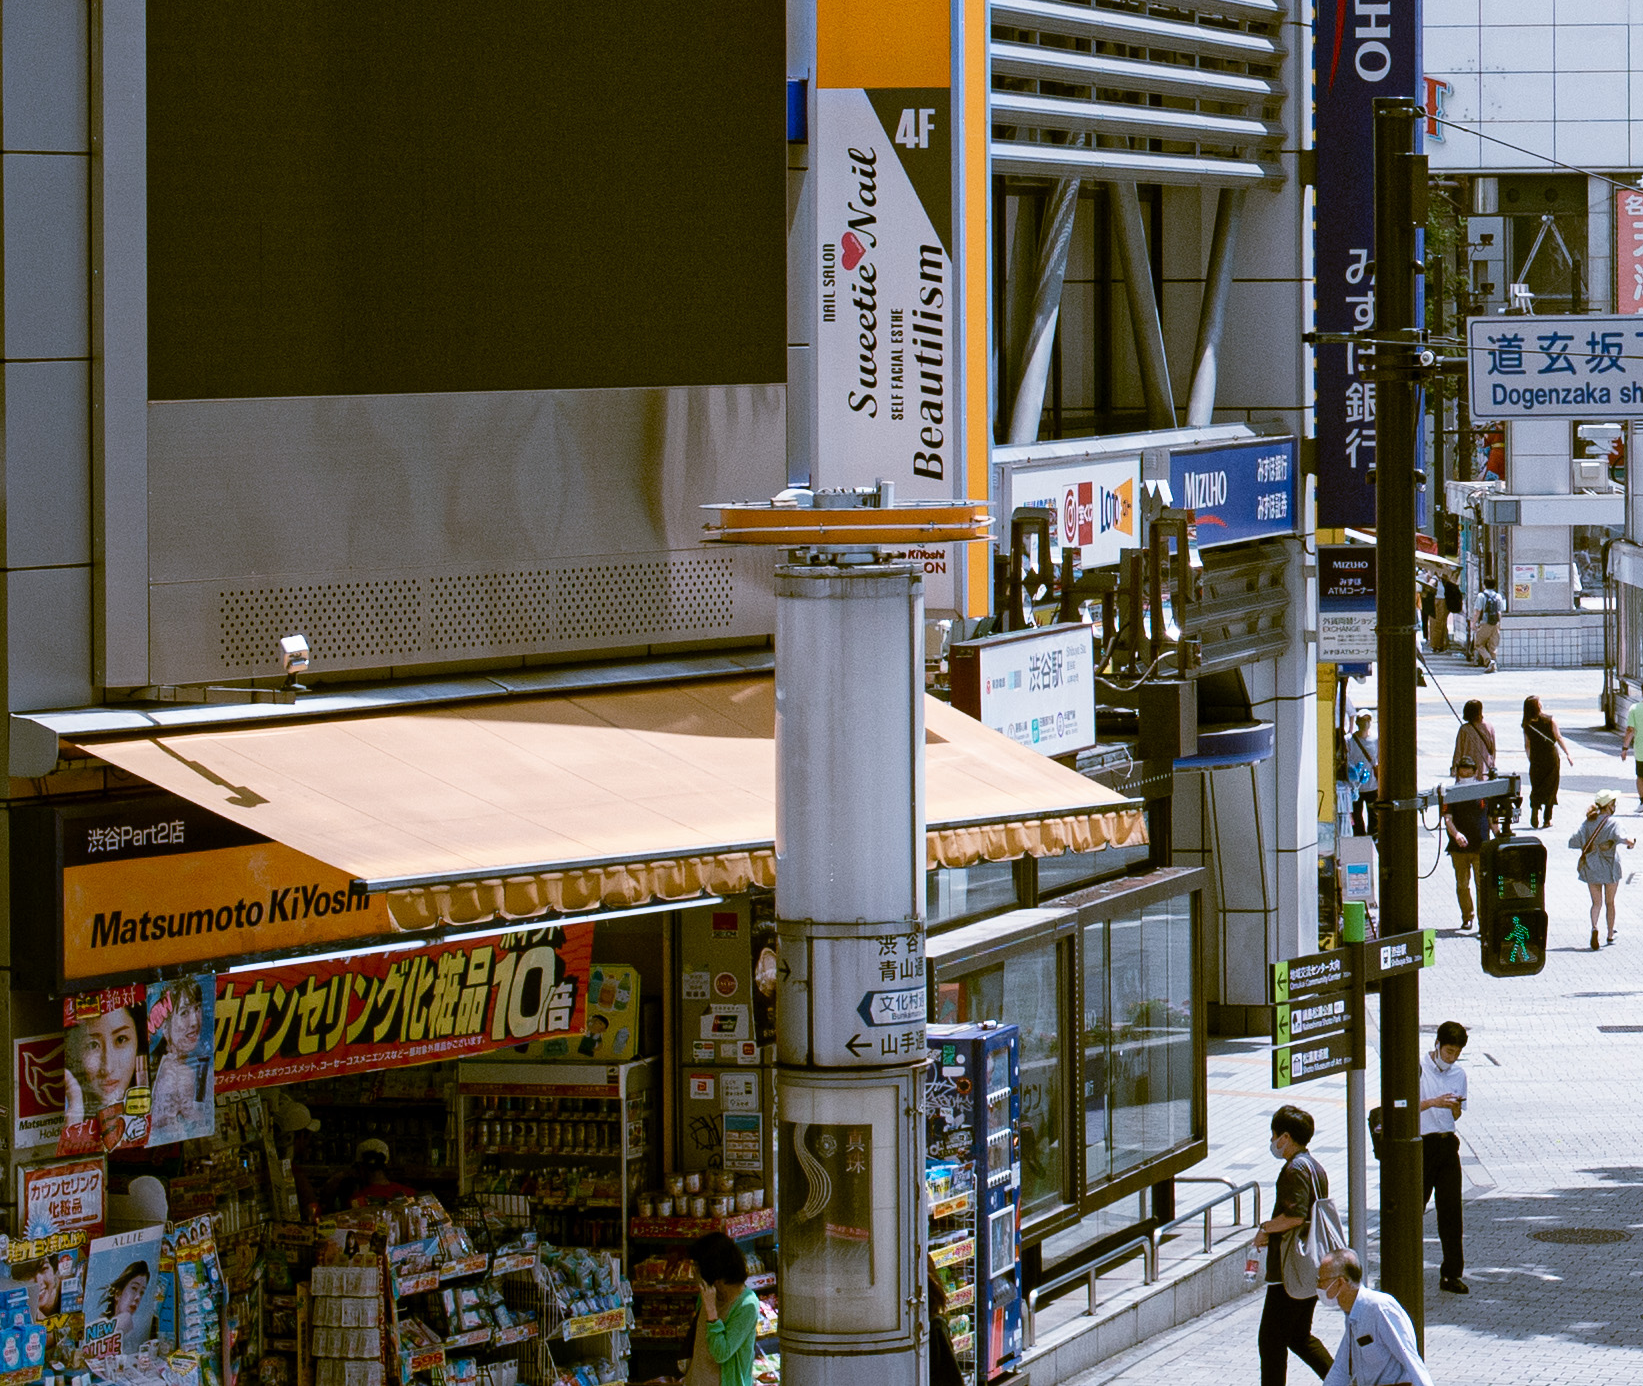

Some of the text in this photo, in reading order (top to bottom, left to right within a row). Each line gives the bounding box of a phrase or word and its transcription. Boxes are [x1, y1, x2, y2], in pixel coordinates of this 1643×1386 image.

[895, 108, 936, 149] 4F
[823, 242, 836, 323] NAIL SALON
[846, 146, 879, 419] Sweetie Nail
[891, 308, 904, 421] SELF FACIAL ESTHE
[912, 243, 945, 482] Beautilism
[1491, 381, 1612, 407] Dogenzaka
[1257, 455, 1288, 482] みずほ銀行
[1184, 470, 1228, 510] MIZUHO
[1333, 561, 1369, 569] MIZUHO
[1327, 586, 1375, 595] ATMコーナー
[1339, 577, 1362, 586] みずほ
[1322, 625, 1361, 633] EXCHANGE
[1029, 649, 1064, 692] 渋谷駅
[87, 820, 185, 853] 渋谷Part2店
[90, 898, 264, 949] Matsumoto
[214, 945, 493, 1072] カウンセリング化粧品
[31, 1174, 99, 1201] カウンセリング
[48, 1198, 83, 1219] 化粧品
[111, 1231, 144, 1248] ALLIE
[85, 1318, 117, 1340] NEW
